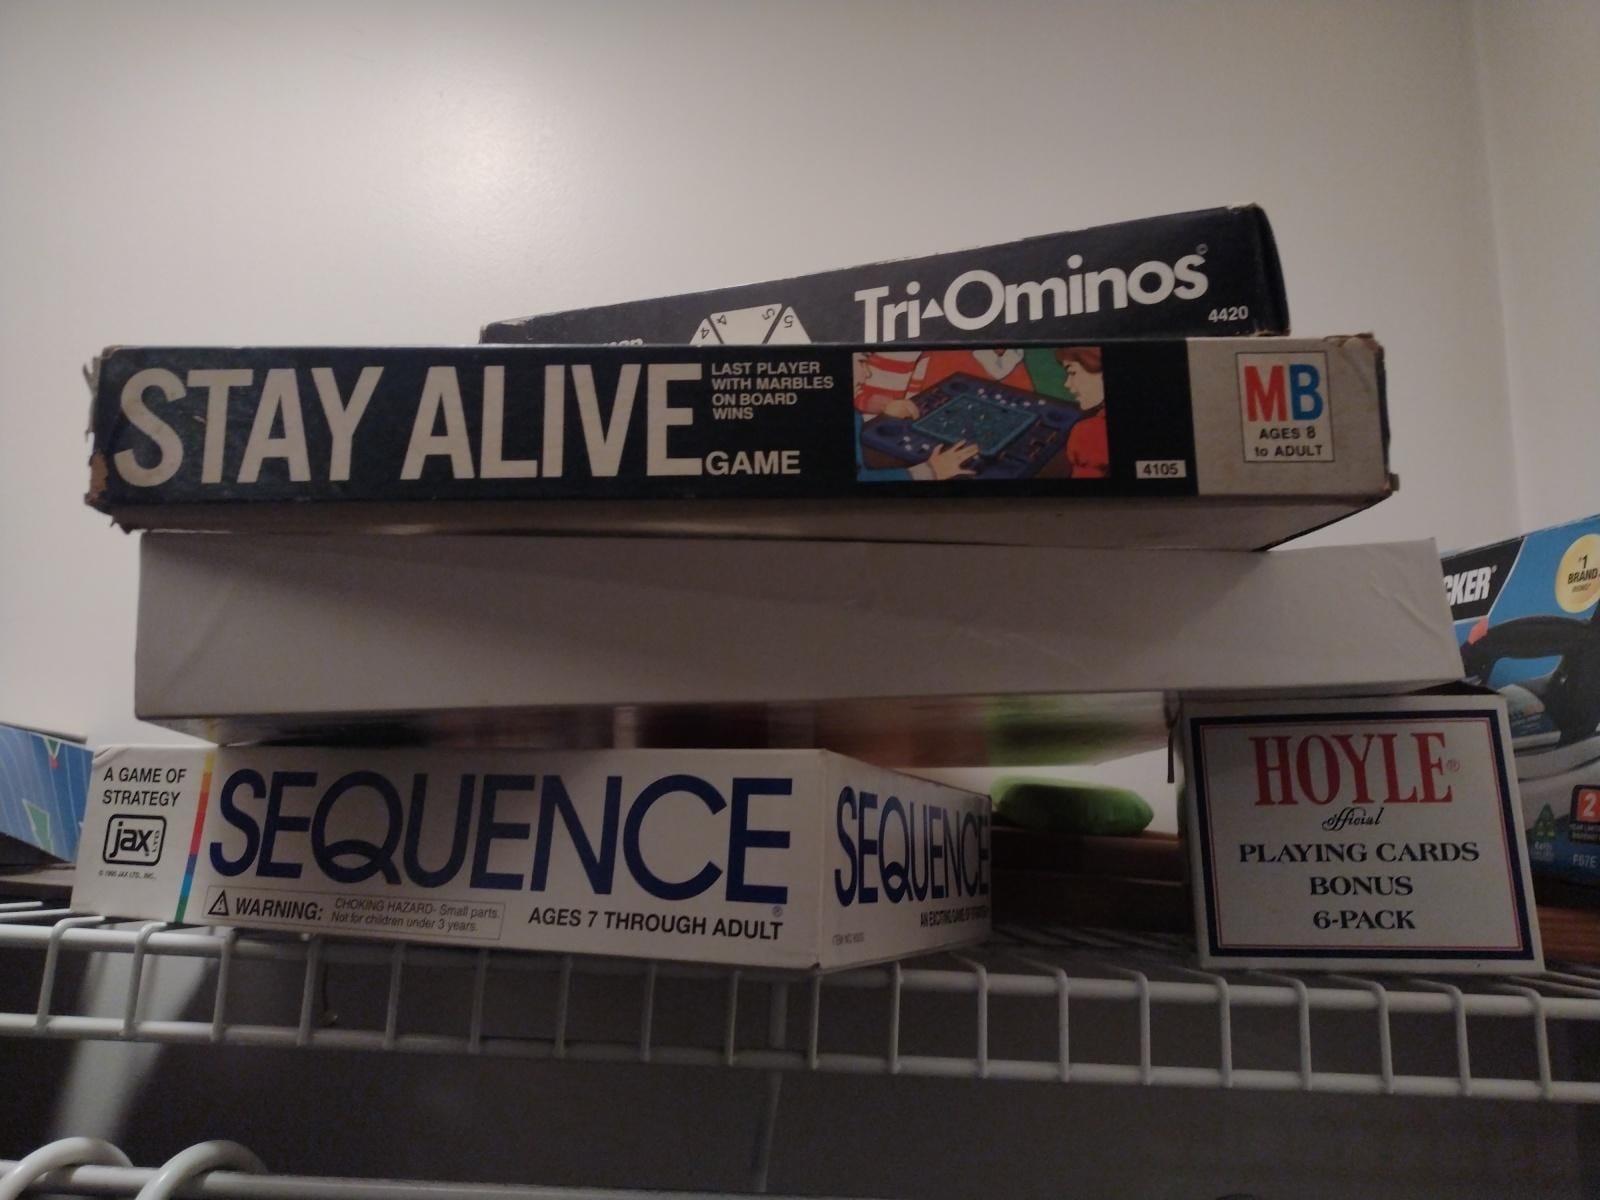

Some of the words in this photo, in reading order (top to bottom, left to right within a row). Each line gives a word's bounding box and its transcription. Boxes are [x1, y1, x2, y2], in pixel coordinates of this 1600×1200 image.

[1207, 305, 1249, 323] 4420
[711, 362, 752, 376] LAST
[756, 361, 820, 375] PLAYER
[711, 377, 751, 391] WITH
[756, 376, 834, 390] MARBLES
[1243, 363, 1324, 422] MB
[711, 393, 737, 406] ON
[739, 392, 798, 406] BOARD
[712, 407, 753, 420] WINS
[113, 366, 384, 487] STAY
[400, 363, 702, 480] ALIVE
[1248, 427, 1300, 439] AGES
[1306, 426, 1316, 439] 8
[1255, 446, 1267, 457] to
[1274, 445, 1323, 457] ADULT
[705, 450, 801, 476] GAME
[1143, 462, 1179, 476] 4105
[103, 767, 114, 782] A
[118, 767, 162, 783] GAME
[166, 768, 187, 783] OF
[1249, 732, 1453, 806] HOYLE
[102, 789, 181, 807] STRATEGY
[1583, 793, 1597, 817] 2
[109, 821, 154, 858] jax
[209, 768, 793, 904] SEQUENCE
[834, 785, 989, 907] SEQUENCE
[1239, 843, 1367, 863] PLAYING
[1376, 842, 1480, 863] CARDS
[1310, 876, 1414, 896] BONUS
[235, 897, 324, 920] WARNING:
[335, 897, 385, 912] CHOKING
[440, 904, 469, 916] Small
[470, 907, 501, 920] parts.
[331, 911, 349, 922] Not
[350, 913, 363, 923] for
[365, 914, 404, 927] children
[406, 917, 436, 928] under
[438, 919, 445, 929] 3
[528, 907, 581, 927] AGES
[588, 911, 598, 927] 7
[603, 912, 707, 935] THROUGH
[712, 918, 783, 940] ADULT
[1312, 909, 1417, 930] 6-PACK
